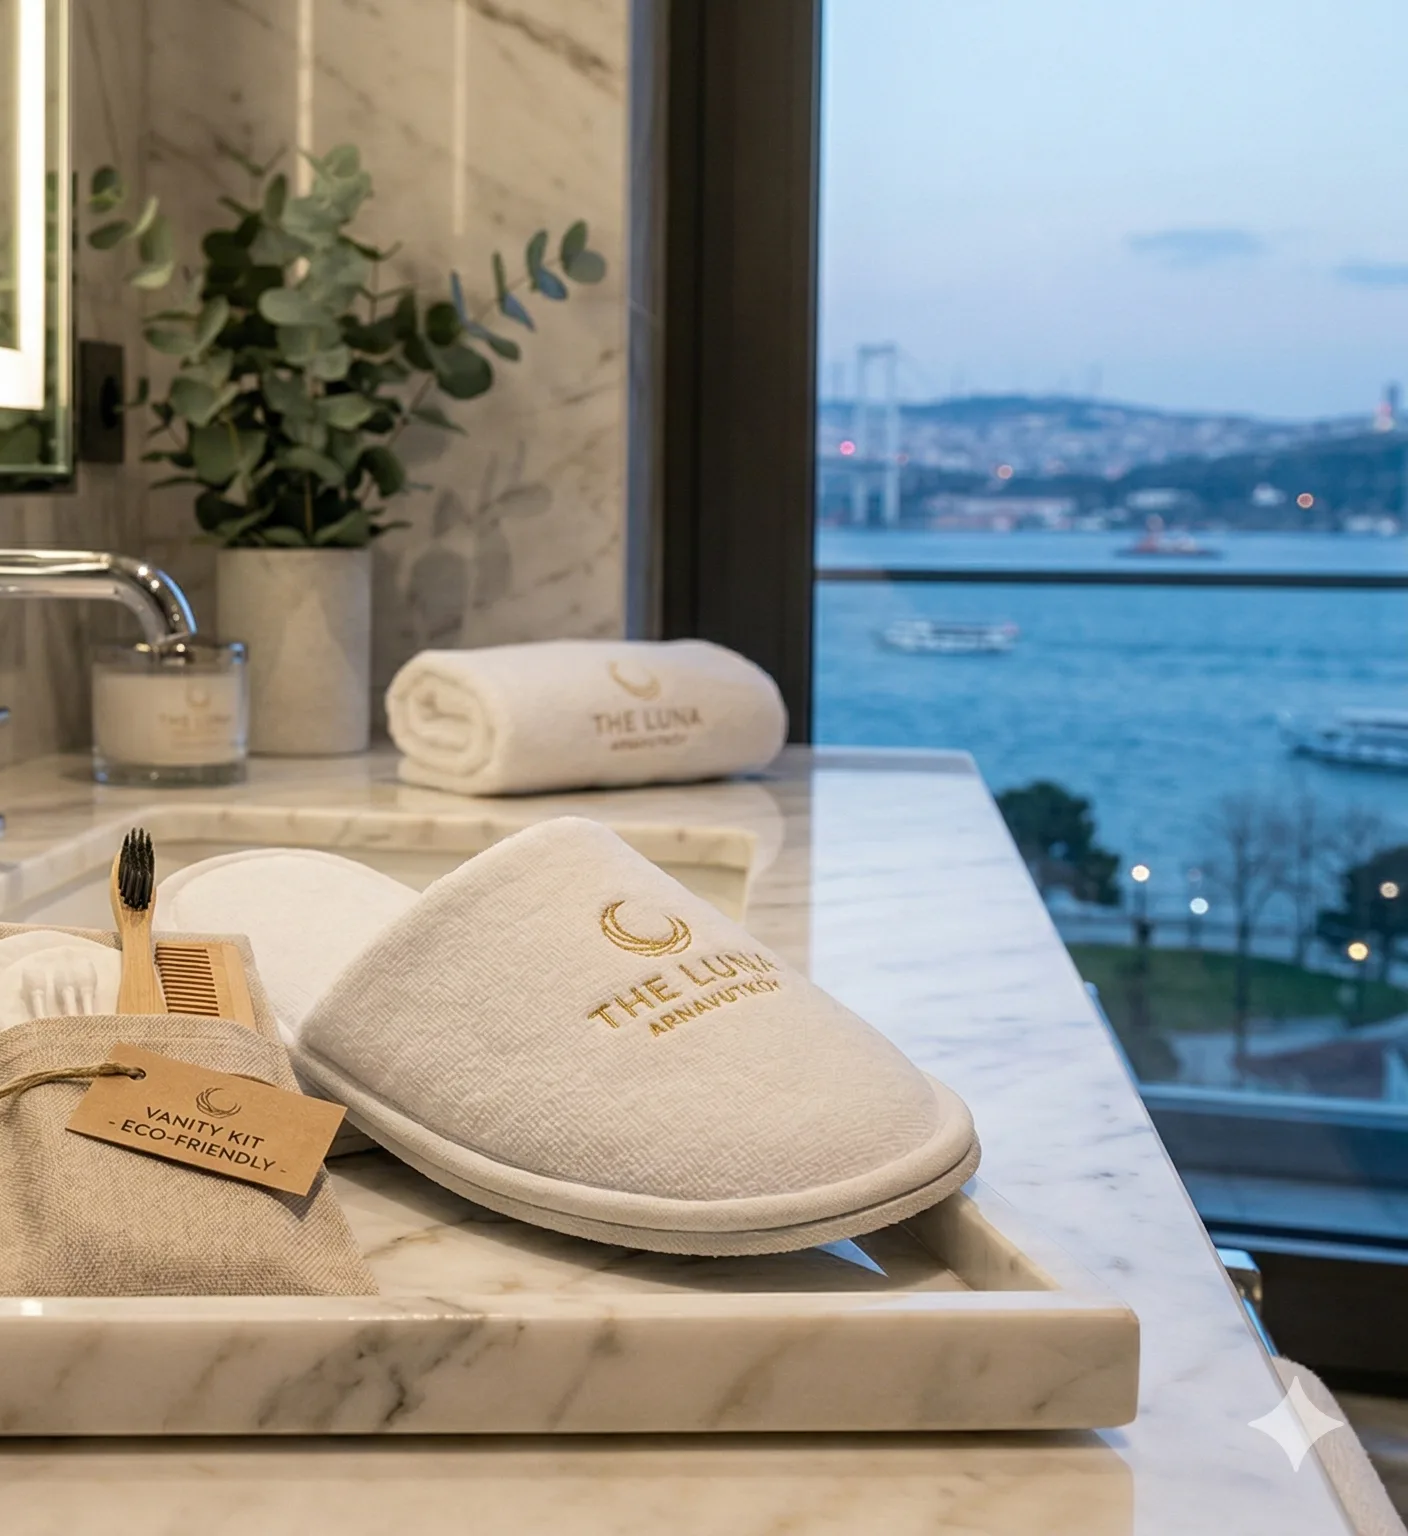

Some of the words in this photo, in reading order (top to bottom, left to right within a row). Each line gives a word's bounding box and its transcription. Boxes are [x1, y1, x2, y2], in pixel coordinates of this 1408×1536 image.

[592, 709, 637, 737] THE
[642, 707, 704, 732] LUNA
[587, 975, 682, 1029] THE
[678, 953, 780, 987] LUNA
[120, 1119, 276, 1172] ECO-FRIENDLY
[146, 1106, 224, 1137] VANITY
[228, 1130, 265, 1150] KIT
